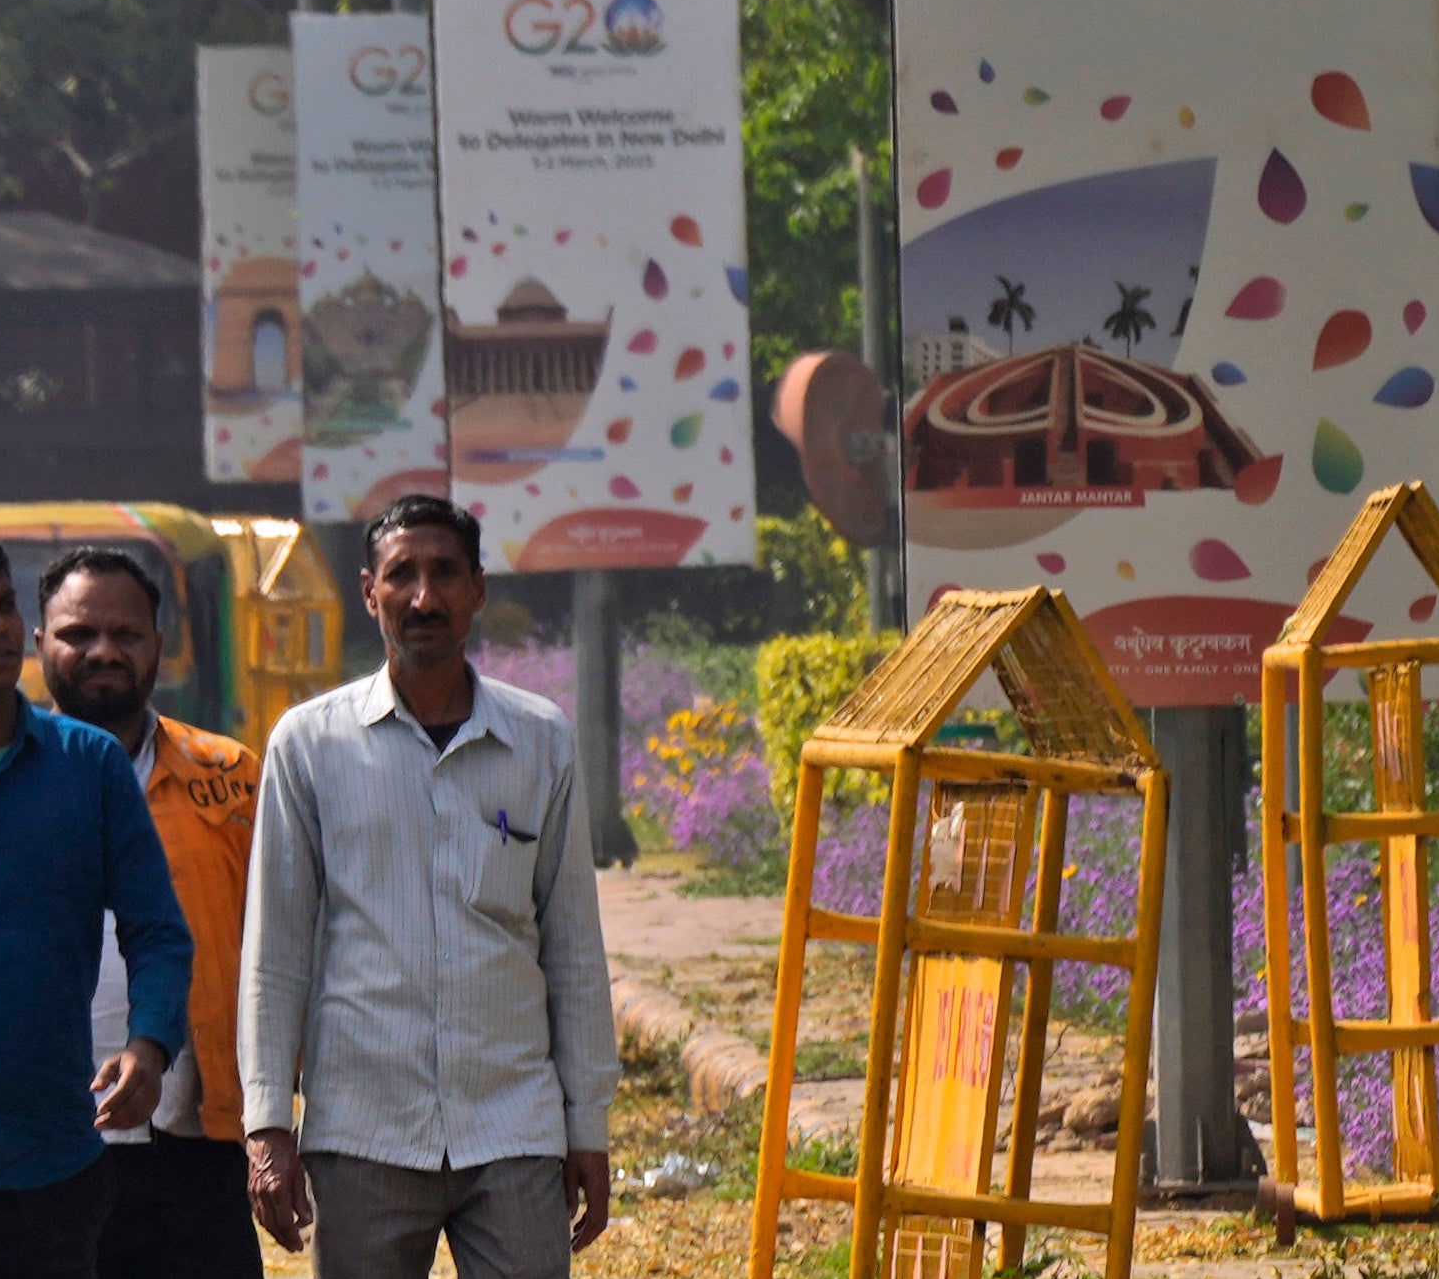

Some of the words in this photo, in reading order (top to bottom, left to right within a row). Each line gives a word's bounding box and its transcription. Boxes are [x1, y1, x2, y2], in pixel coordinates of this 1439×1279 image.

[348, 44, 428, 96] G2
[1021, 490, 1072, 503] JANTAR
[1076, 490, 1132, 503] MANTAR
[1175, 664, 1219, 674] FAMILY
